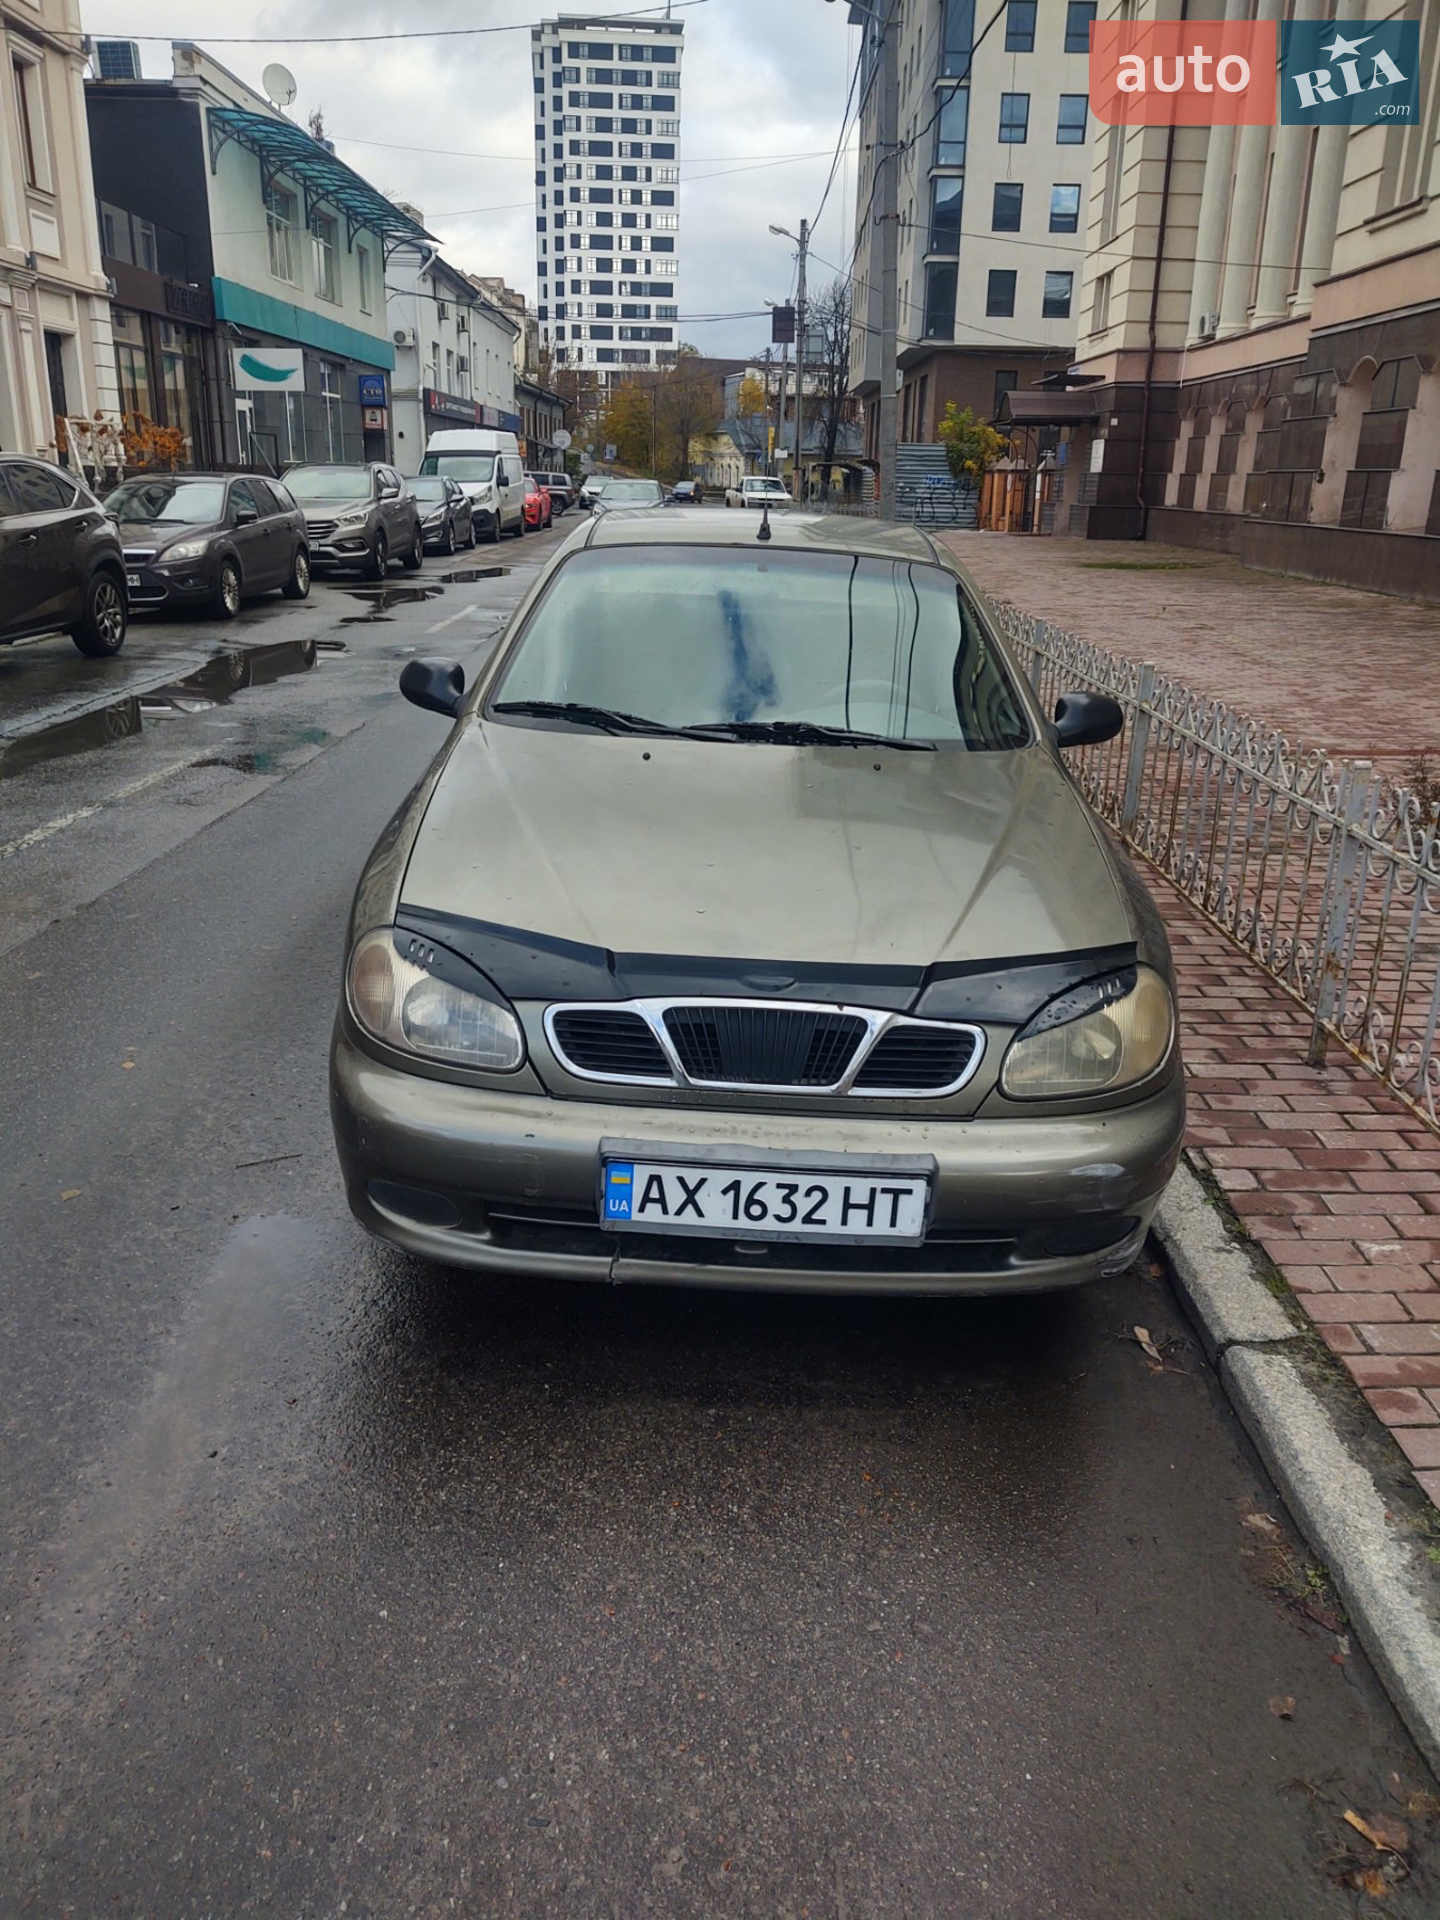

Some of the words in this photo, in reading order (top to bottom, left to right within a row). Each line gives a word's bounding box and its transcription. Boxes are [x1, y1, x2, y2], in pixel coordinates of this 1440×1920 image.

[609, 1199, 629, 1213] UA
[637, 1174, 709, 1219] AX
[720, 1179, 830, 1226] 1632
[840, 1186, 914, 1229] HT
